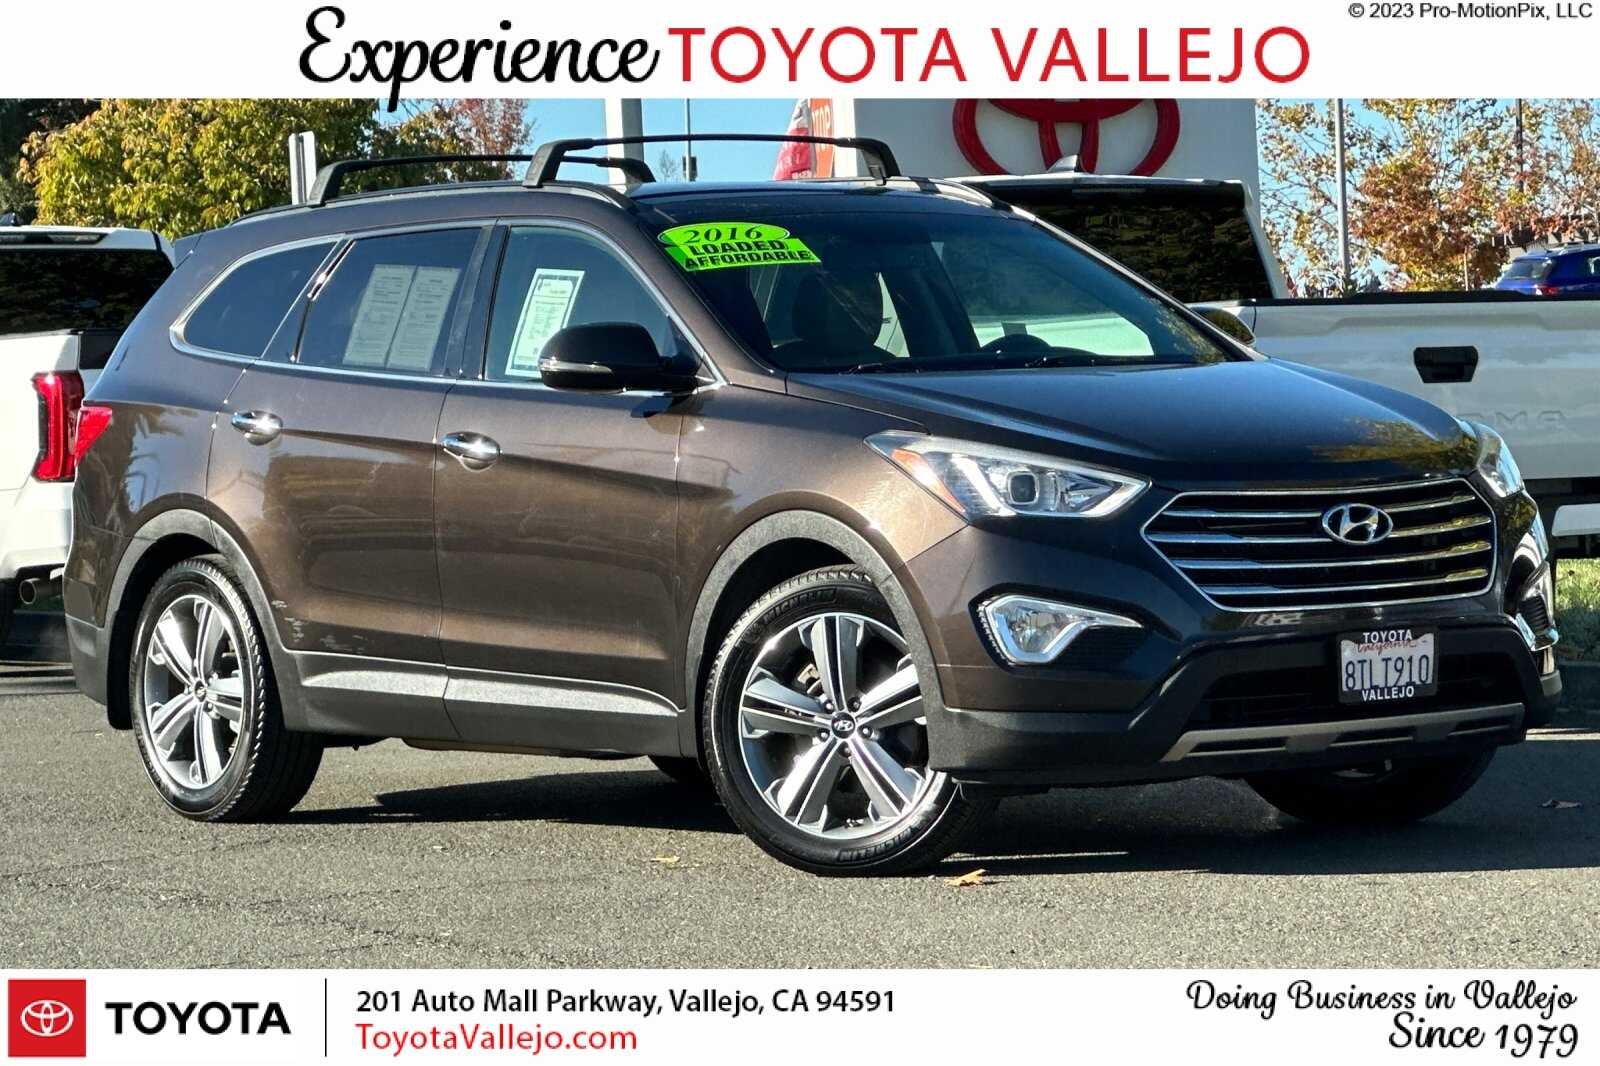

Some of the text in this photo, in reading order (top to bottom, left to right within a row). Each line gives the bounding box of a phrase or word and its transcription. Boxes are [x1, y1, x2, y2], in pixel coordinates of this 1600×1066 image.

[684, 226, 762, 243] 2016
[685, 250, 813, 268] AFFORDABLE
[1362, 629, 1413, 643] TOYOTA
[1345, 654, 1430, 691] 8TLT910
[1362, 686, 1415, 702] VALLEJO
